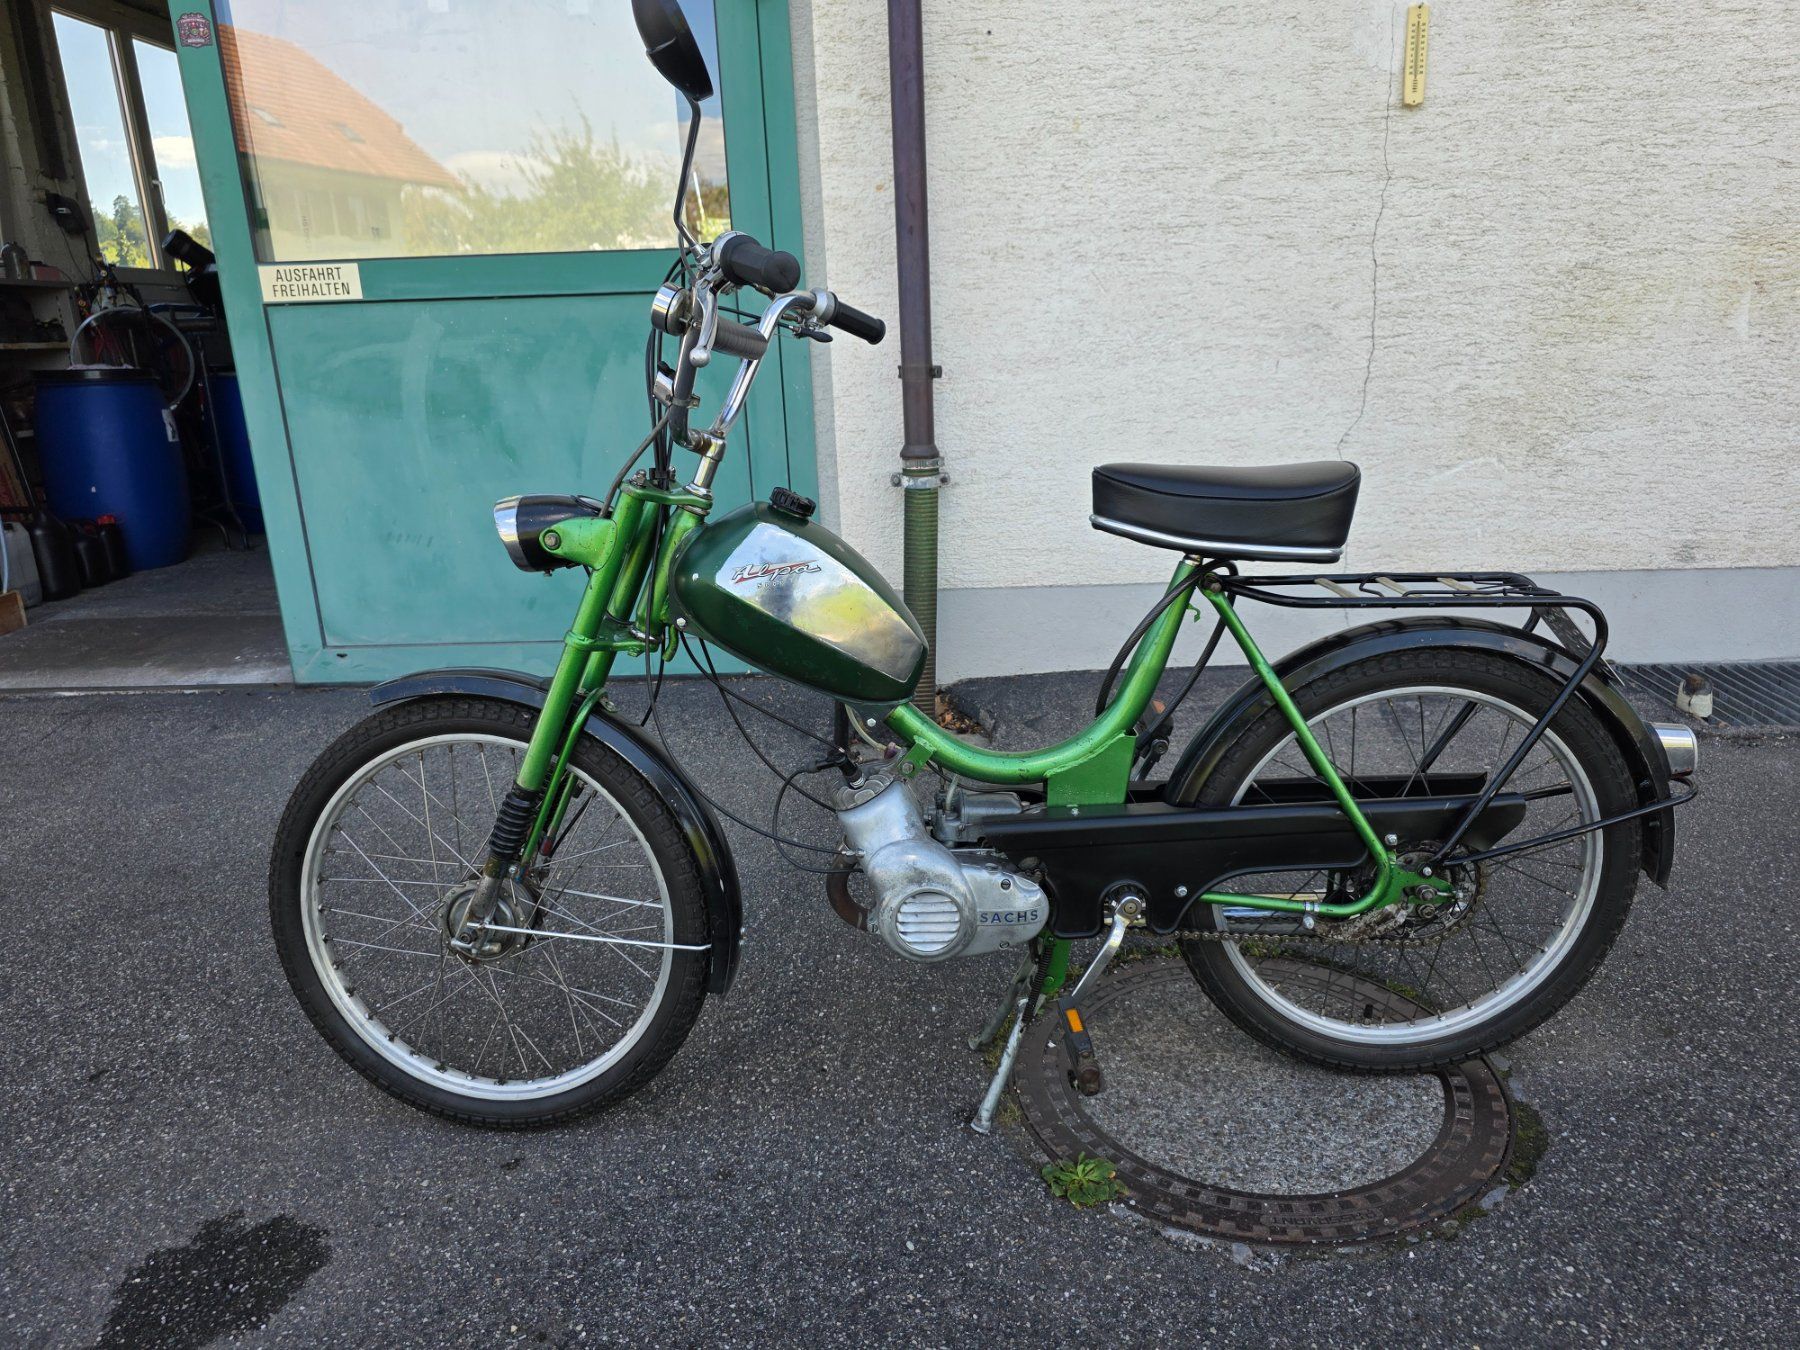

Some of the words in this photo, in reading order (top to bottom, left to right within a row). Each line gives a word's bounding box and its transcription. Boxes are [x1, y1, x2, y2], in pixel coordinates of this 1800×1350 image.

[276, 267, 342, 283] AUSFAHRT
[273, 282, 351, 298] FREIHALTEN
[732, 562, 822, 580] Alpa
[980, 909, 1039, 924] SACHS
